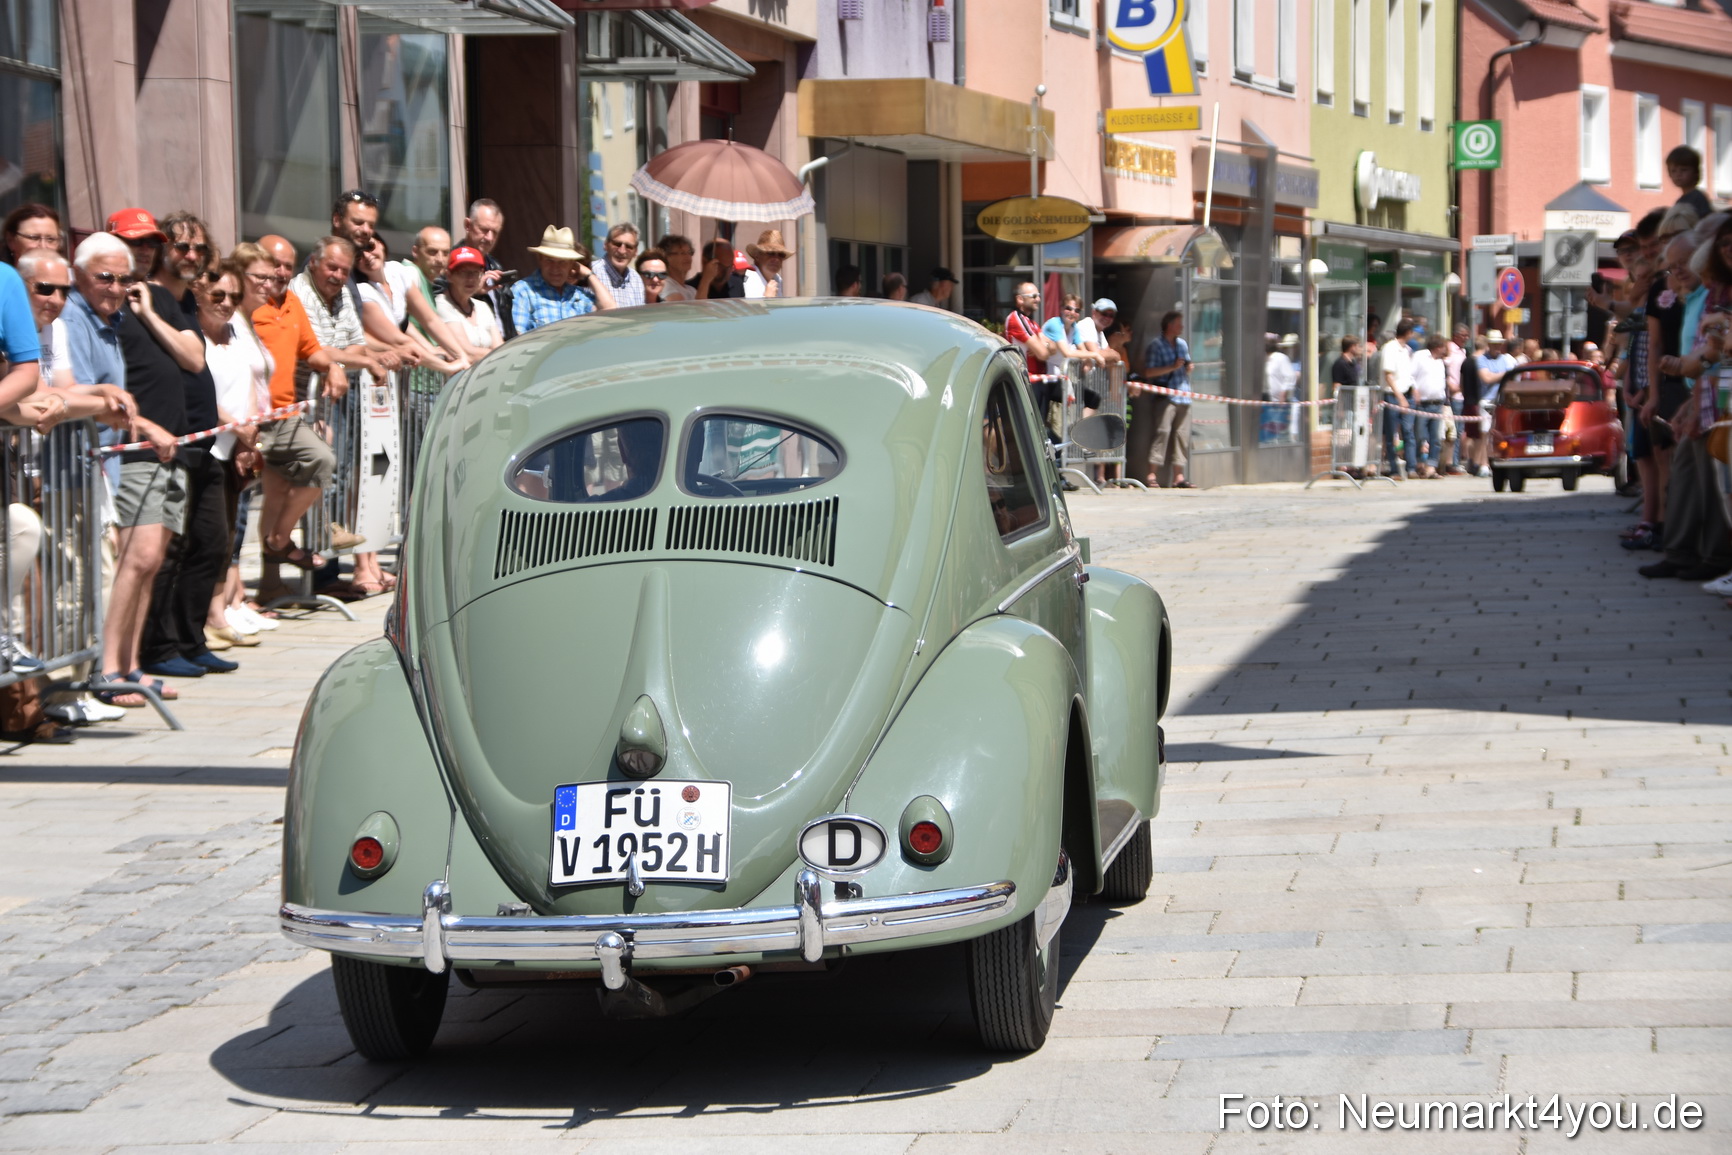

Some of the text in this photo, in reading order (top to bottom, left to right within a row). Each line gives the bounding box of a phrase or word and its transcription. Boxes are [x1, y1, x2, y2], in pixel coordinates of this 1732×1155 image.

[1116, 0, 1157, 28] B
[1111, 112, 1194, 126] KLOSTERGASSE 4
[982, 215, 1089, 225] DIE GOLDSCHMIEDE
[561, 814, 570, 826] D
[604, 787, 661, 829] FÜ
[560, 836, 581, 876] V
[828, 822, 862, 866] D
